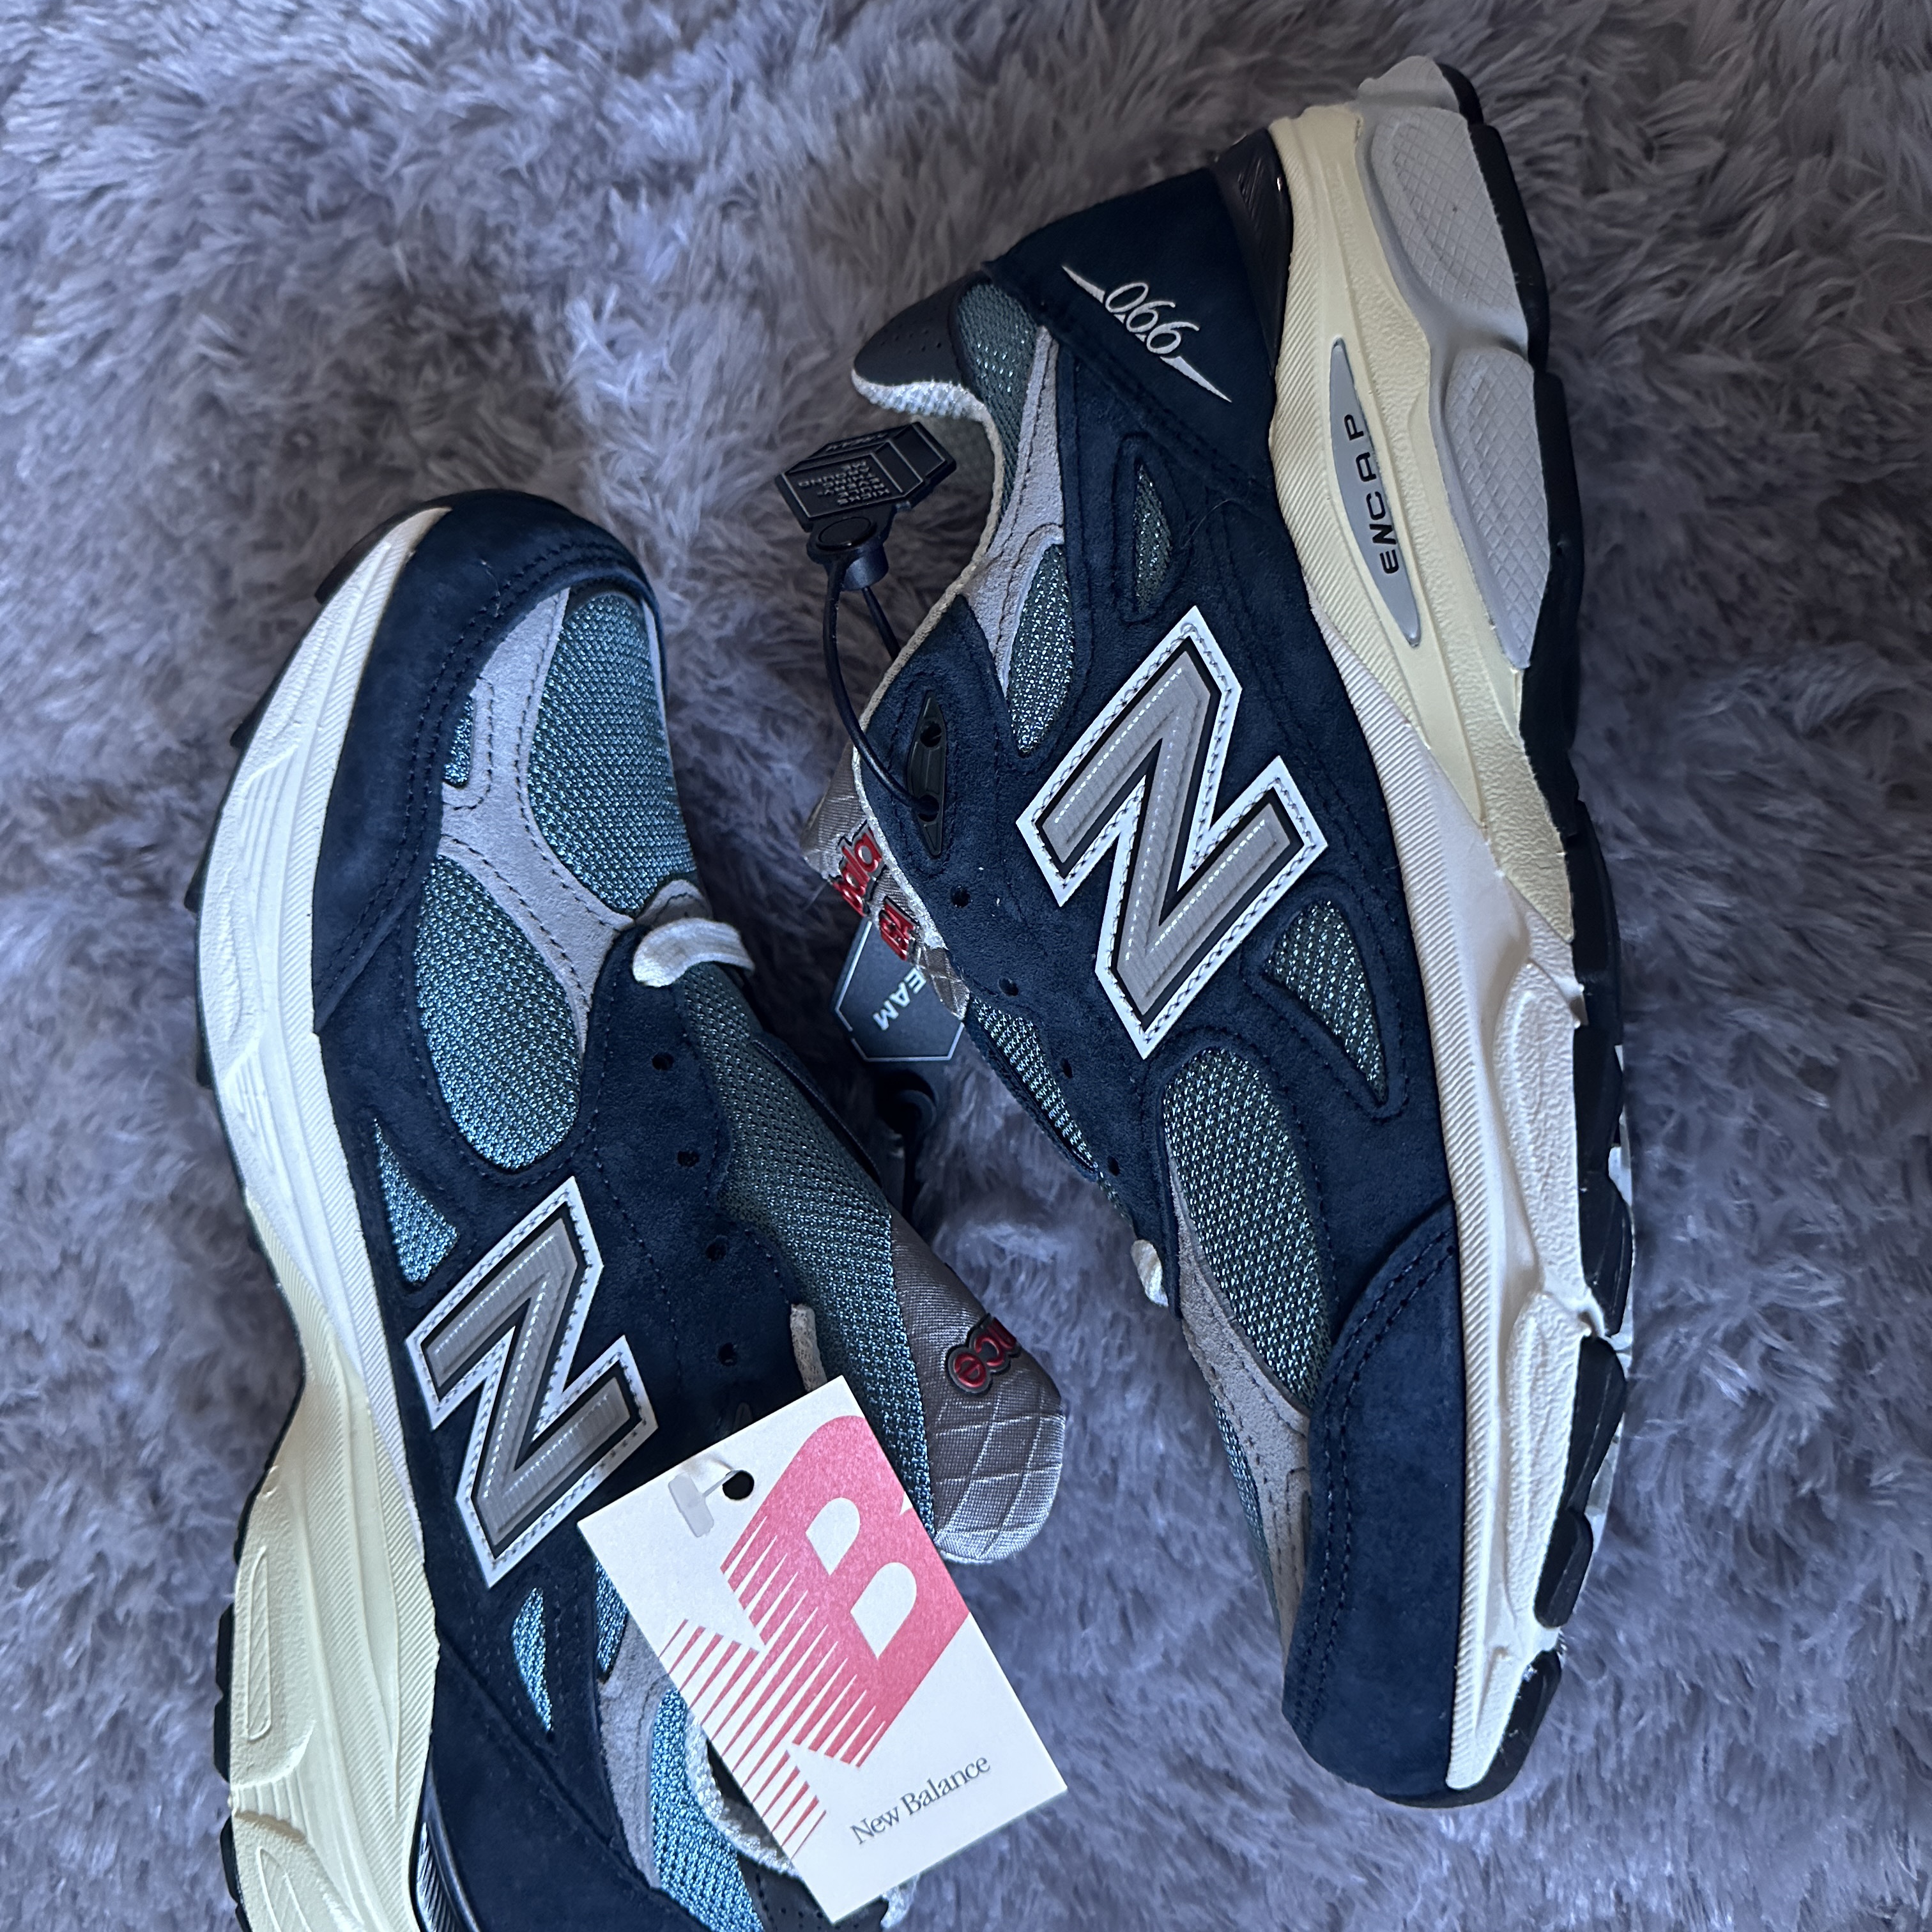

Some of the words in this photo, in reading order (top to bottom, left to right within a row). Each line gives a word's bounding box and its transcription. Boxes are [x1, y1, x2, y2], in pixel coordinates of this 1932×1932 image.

[1105, 282, 1200, 355] 990
[1344, 414, 1399, 574] ENCAP
[1016, 606, 1328, 1059] N
[406, 1176, 659, 1588] N
[849, 1805, 900, 1845] New
[899, 1756, 991, 1816] Balance
